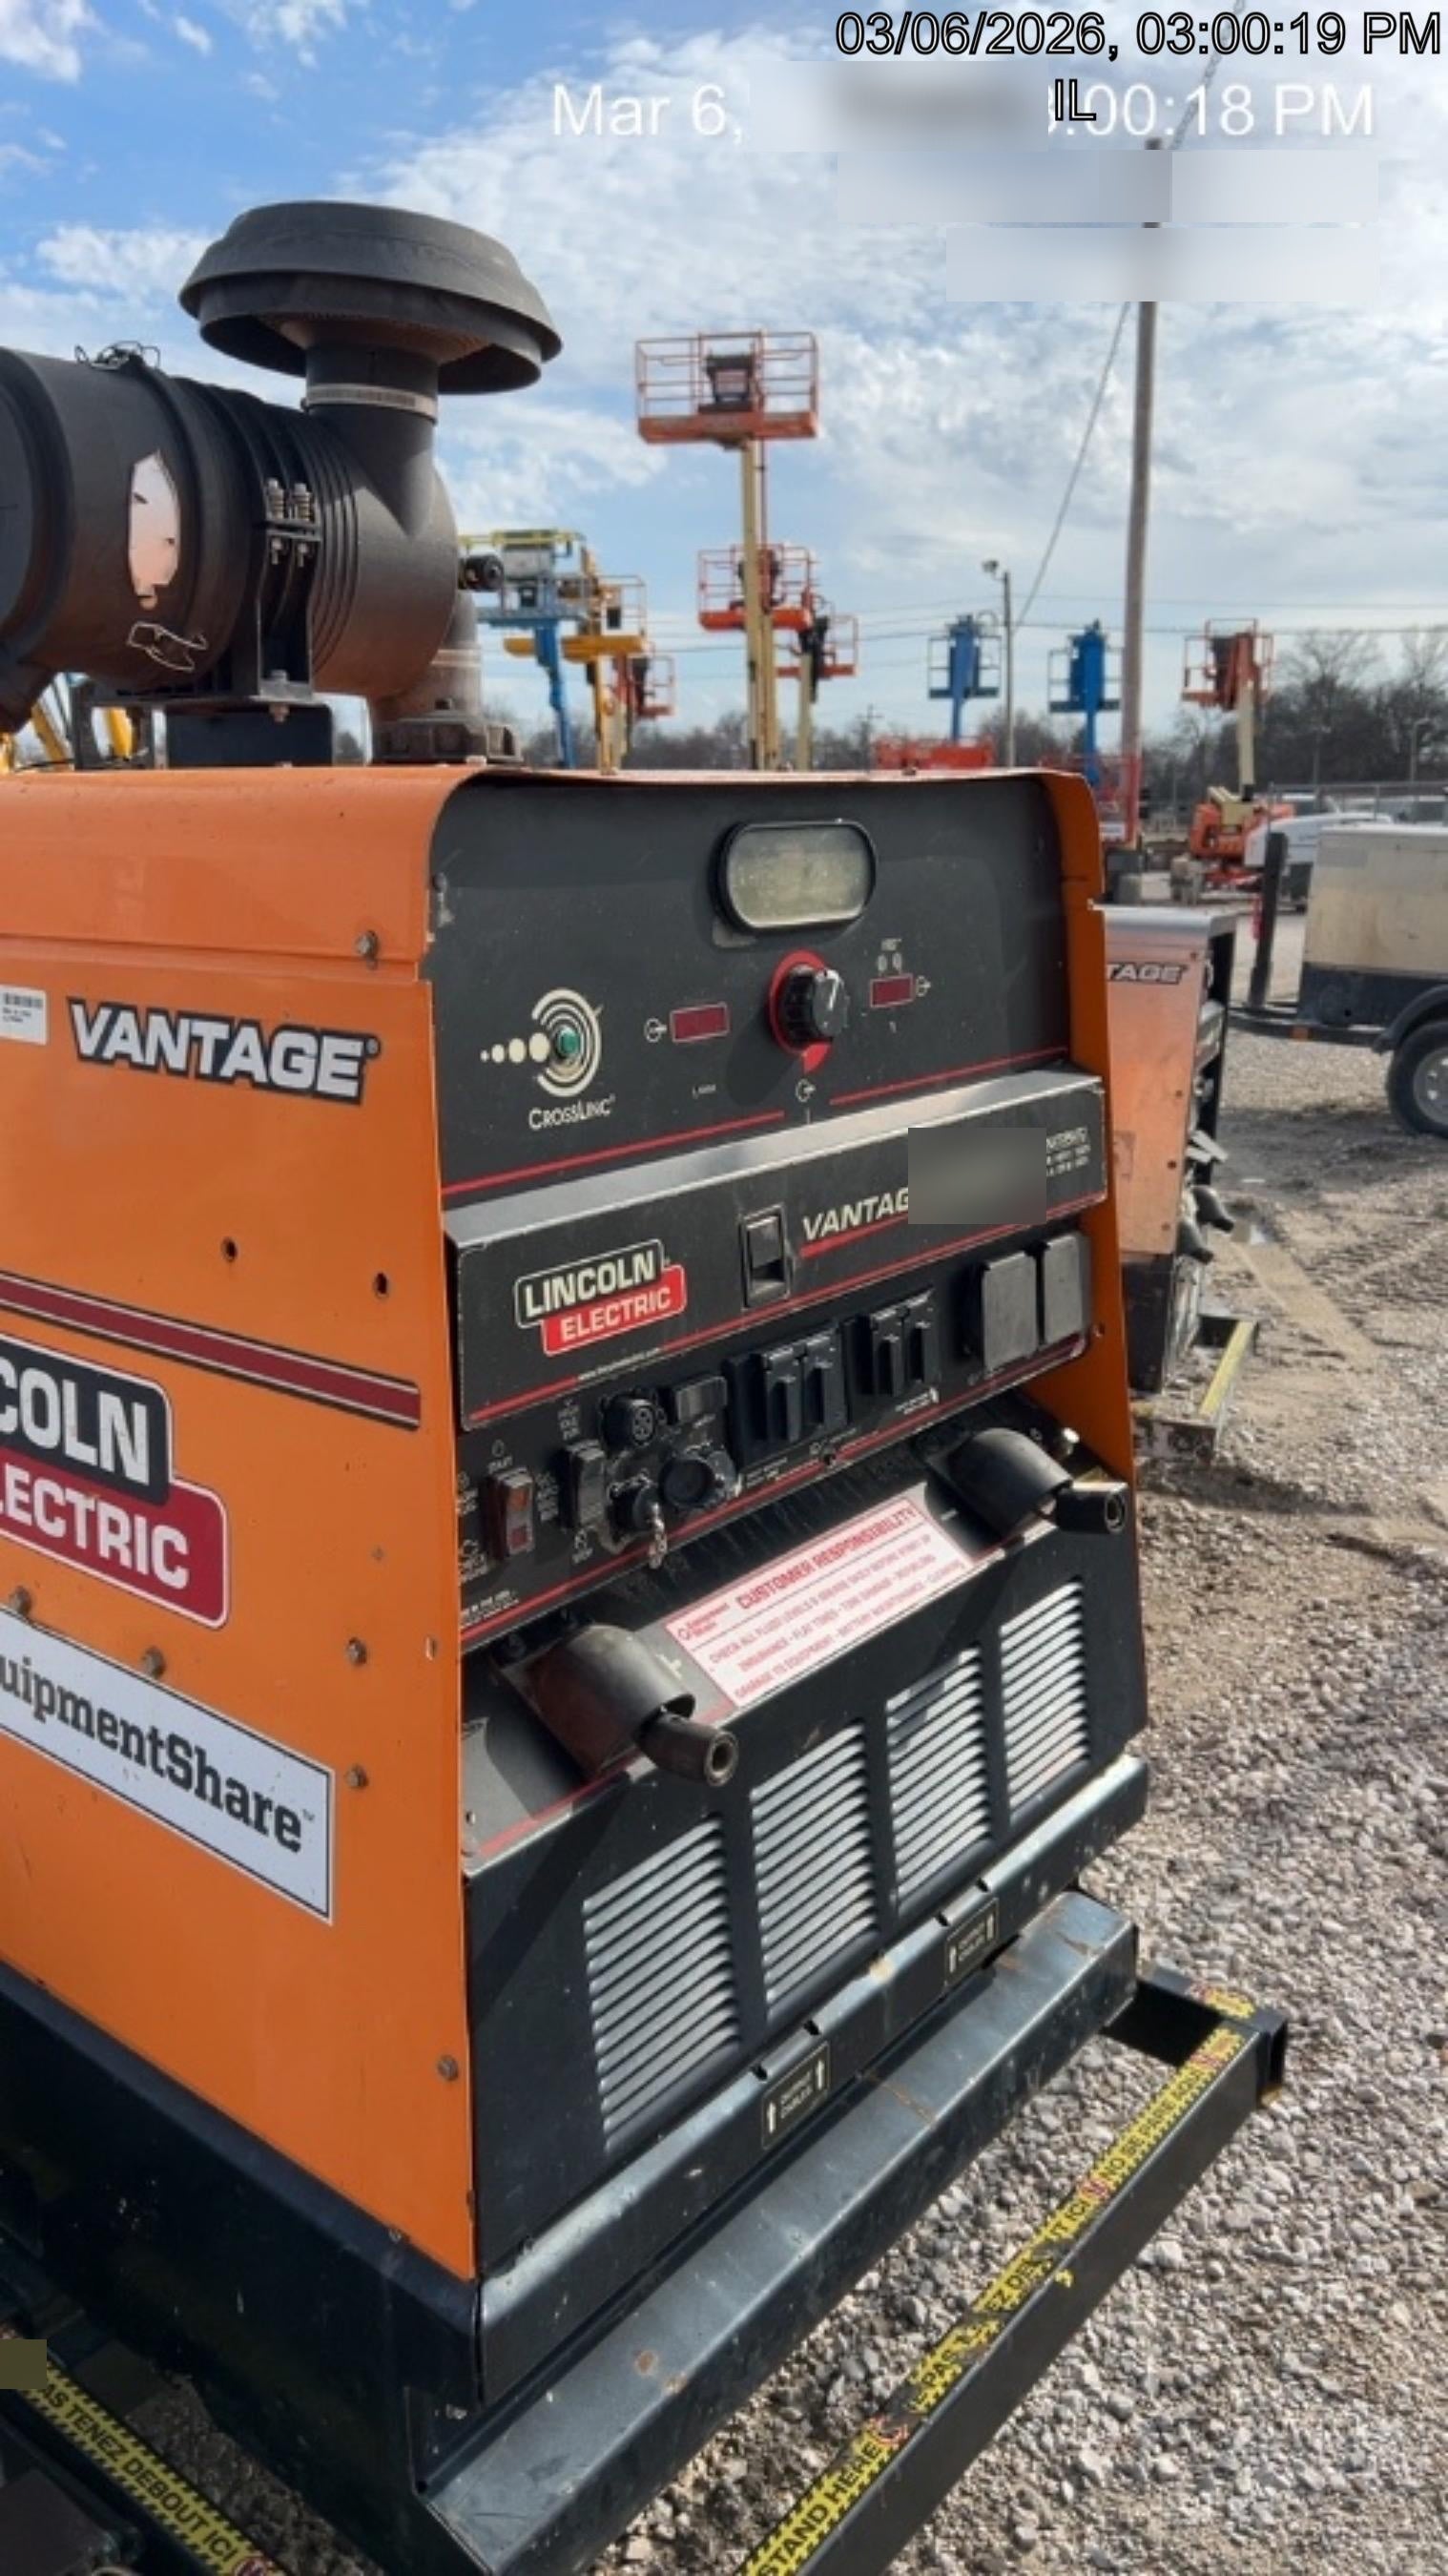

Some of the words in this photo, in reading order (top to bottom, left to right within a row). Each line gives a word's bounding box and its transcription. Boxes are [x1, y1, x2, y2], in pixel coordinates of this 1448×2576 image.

[70, 1002, 368, 1102] VANTAGE
[526, 1250, 654, 1318] LINCOLN
[561, 1287, 672, 1342] ELECTRIC
[736, 1562, 815, 1609] CUSTOMER
[813, 1506, 918, 1568] RESPONSIBILITY
[64, 2406, 129, 2462] TENEZ
[122, 2457, 210, 2532] DEBOUT
[202, 2529, 238, 2562] ICI
